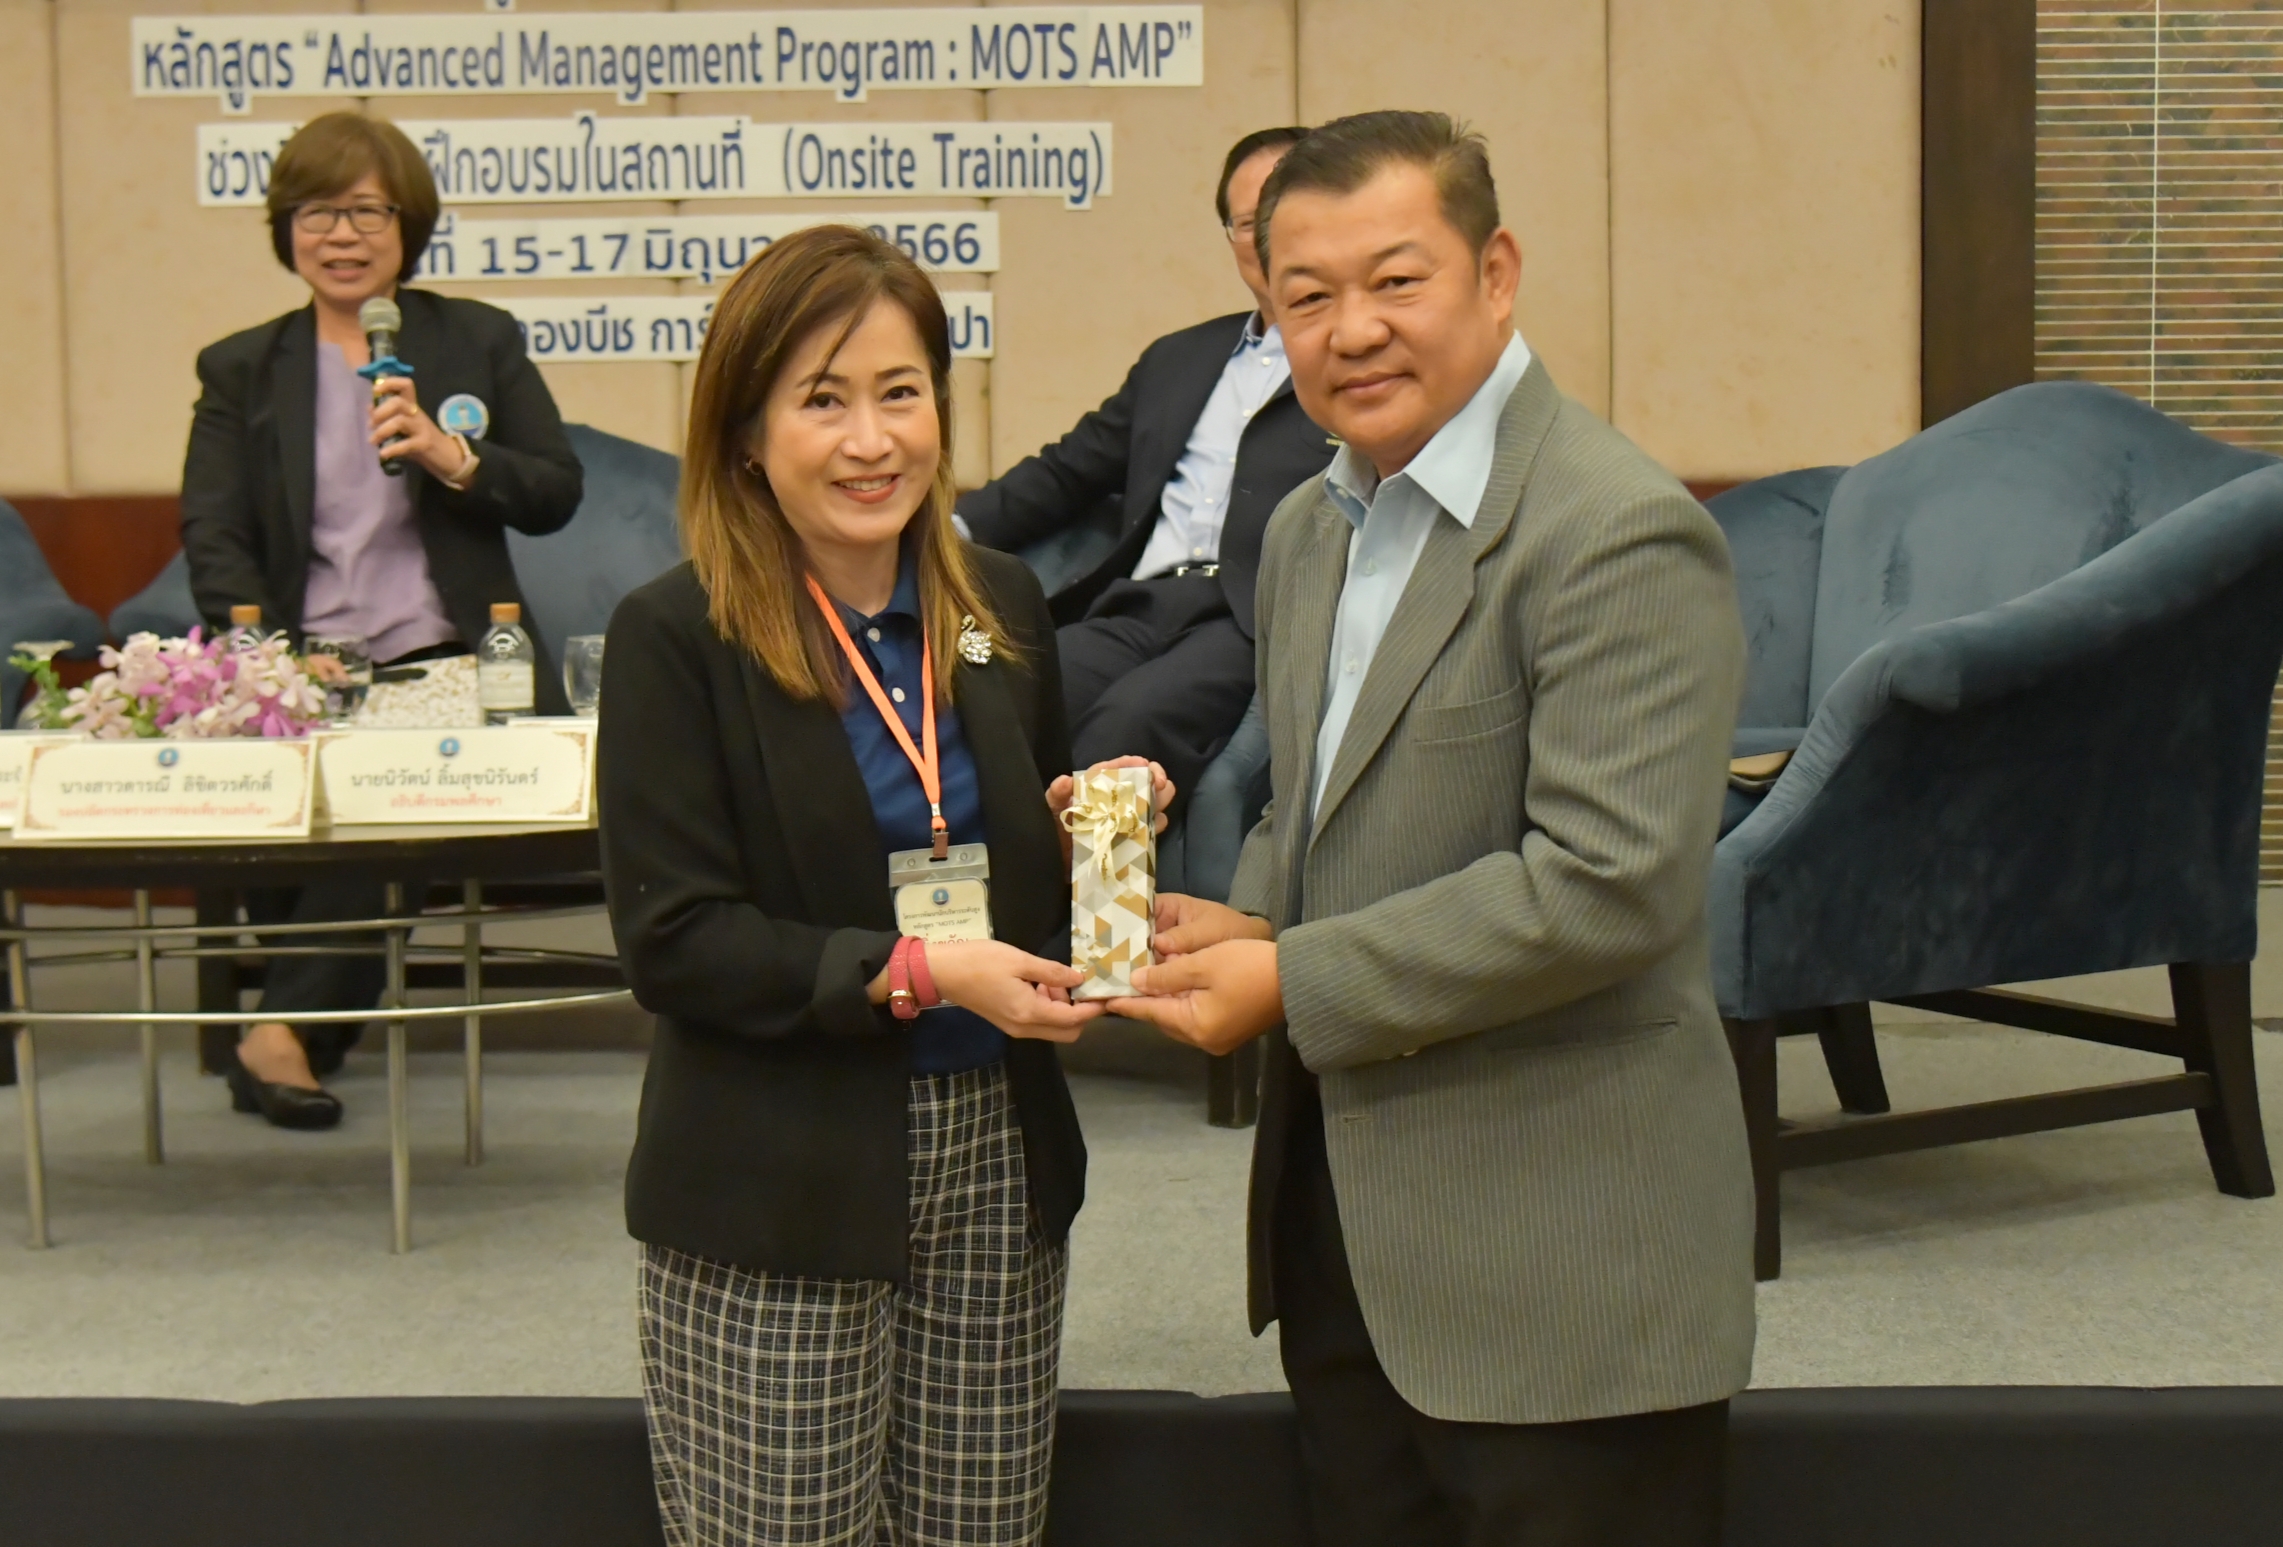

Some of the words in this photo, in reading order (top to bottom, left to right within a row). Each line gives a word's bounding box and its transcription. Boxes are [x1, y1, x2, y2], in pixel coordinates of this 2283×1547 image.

[144, 26, 294, 109] หลักสูตร
[304, 31, 504, 88] “Advanced
[519, 29, 763, 101] Management
[776, 26, 935, 98] Program
[971, 22, 1079, 81] MOTS
[1090, 21, 1192, 79] AMP”
[783, 127, 916, 193] (Onsite
[933, 129, 1103, 205] Training)
[481, 233, 629, 275] 15-17
[948, 305, 990, 350] ปา
